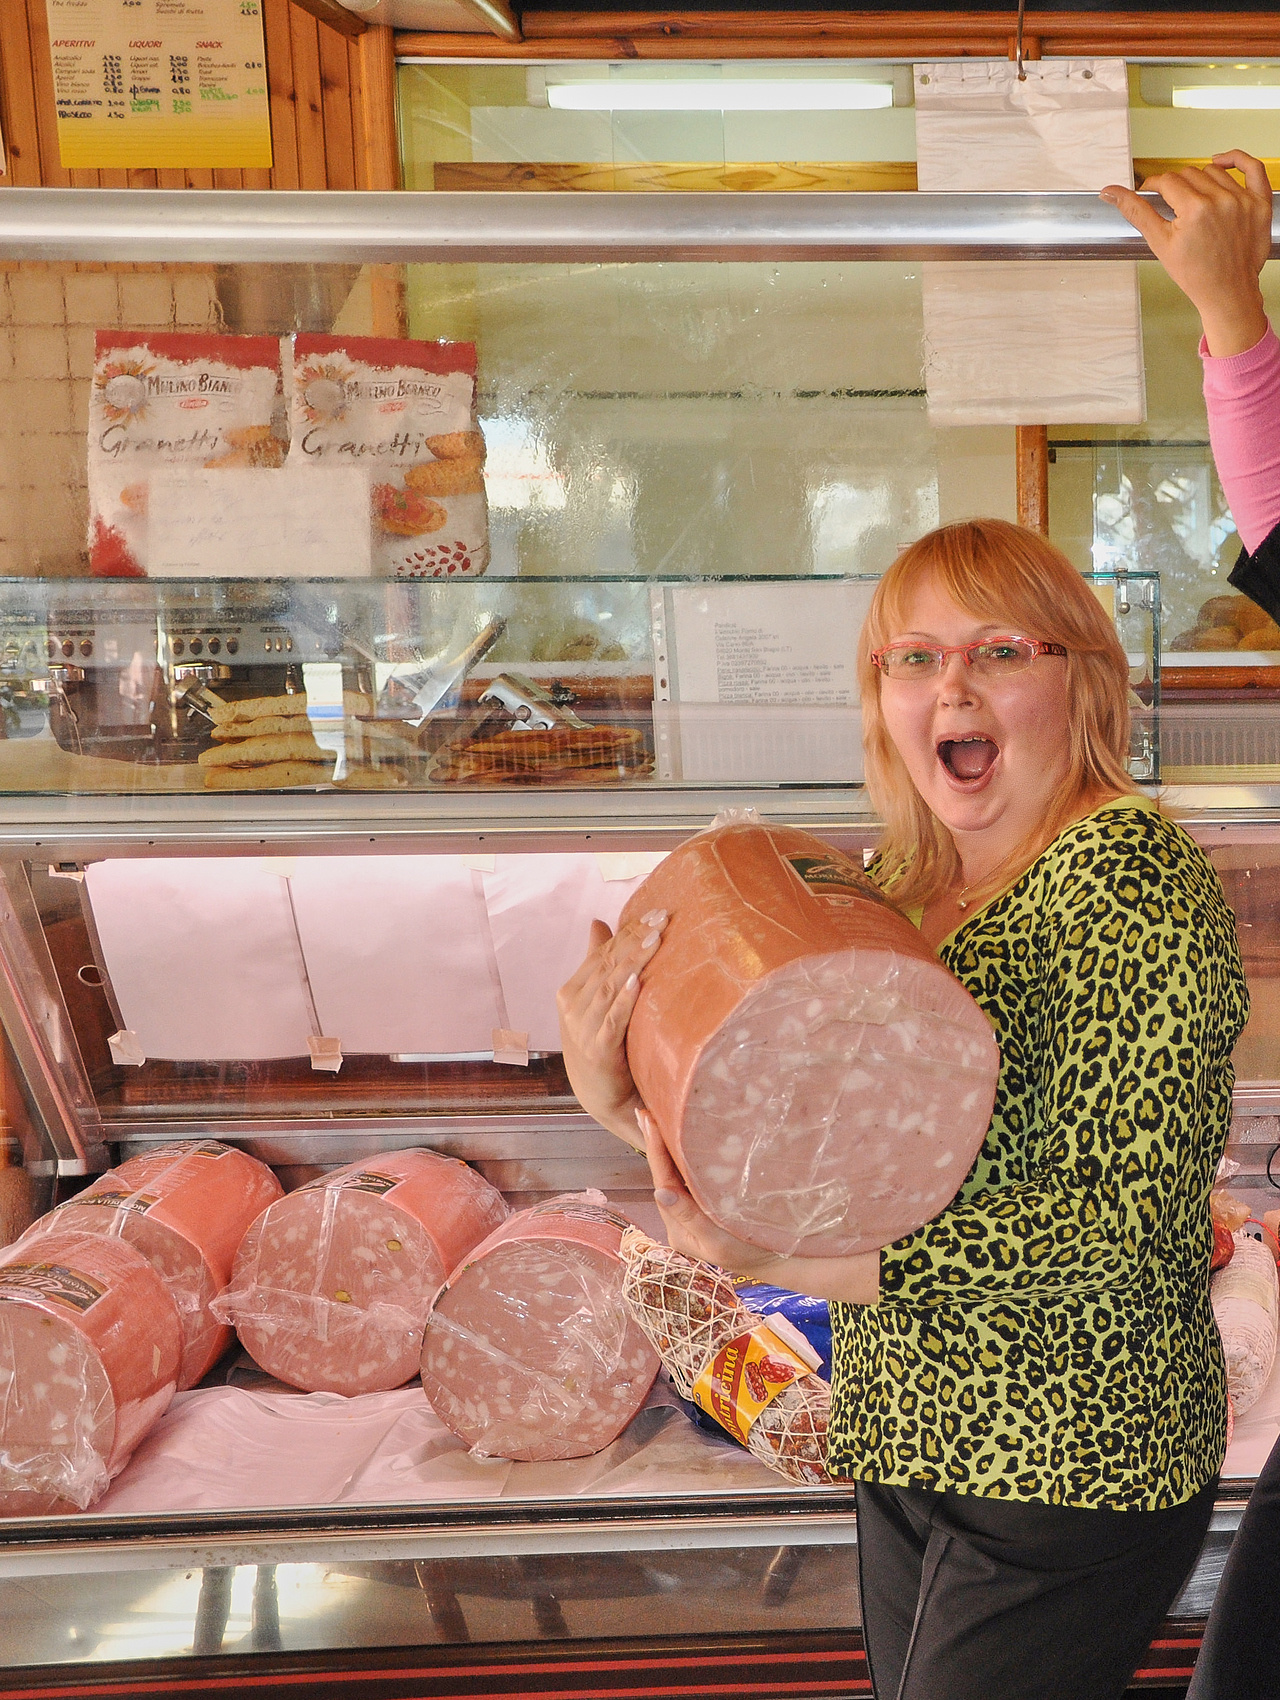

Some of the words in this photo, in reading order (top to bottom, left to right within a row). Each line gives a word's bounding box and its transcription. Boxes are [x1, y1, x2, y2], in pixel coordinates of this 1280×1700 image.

[128, 40, 162, 48] LIQUORI
[196, 40, 223, 48] SNACK
[99, 422, 223, 458] Granetti
[301, 427, 425, 457] Granetti
